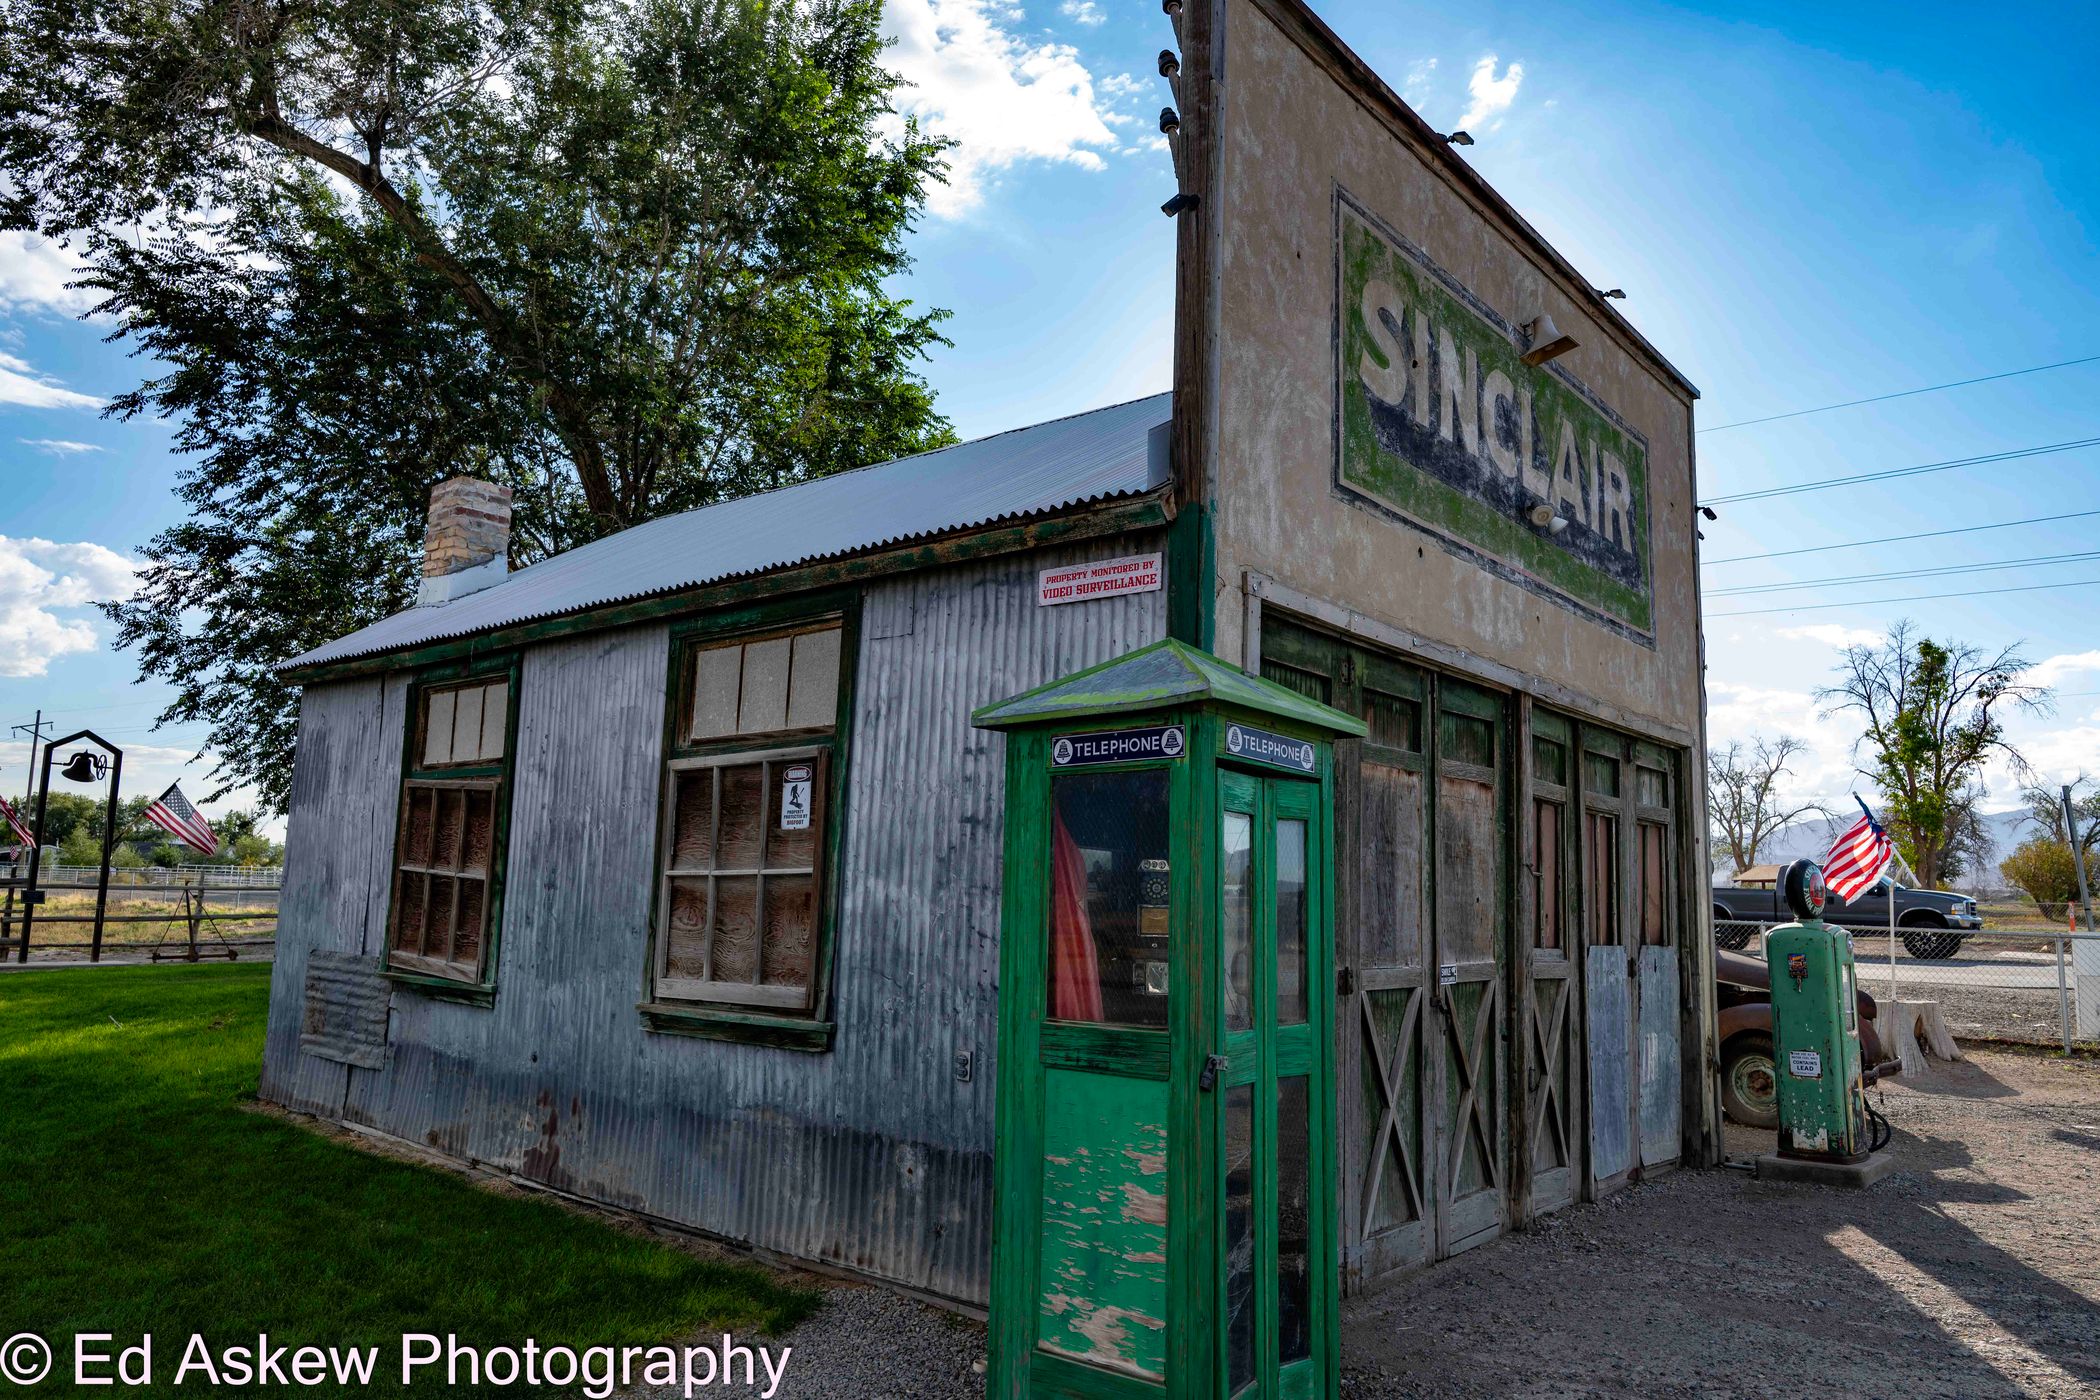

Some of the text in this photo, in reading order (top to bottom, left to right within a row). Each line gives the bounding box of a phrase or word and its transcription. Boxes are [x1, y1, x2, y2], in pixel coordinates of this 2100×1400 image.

[1359, 279, 1633, 554] SINCLAIR
[1046, 560, 1155, 585] PROPERTY MONITORED BY
[1043, 574, 1157, 600] VIDEO SURVEILLANCE
[1074, 735, 1160, 757] TELEPHONE
[1243, 734, 1300, 761] TELEPHONE
